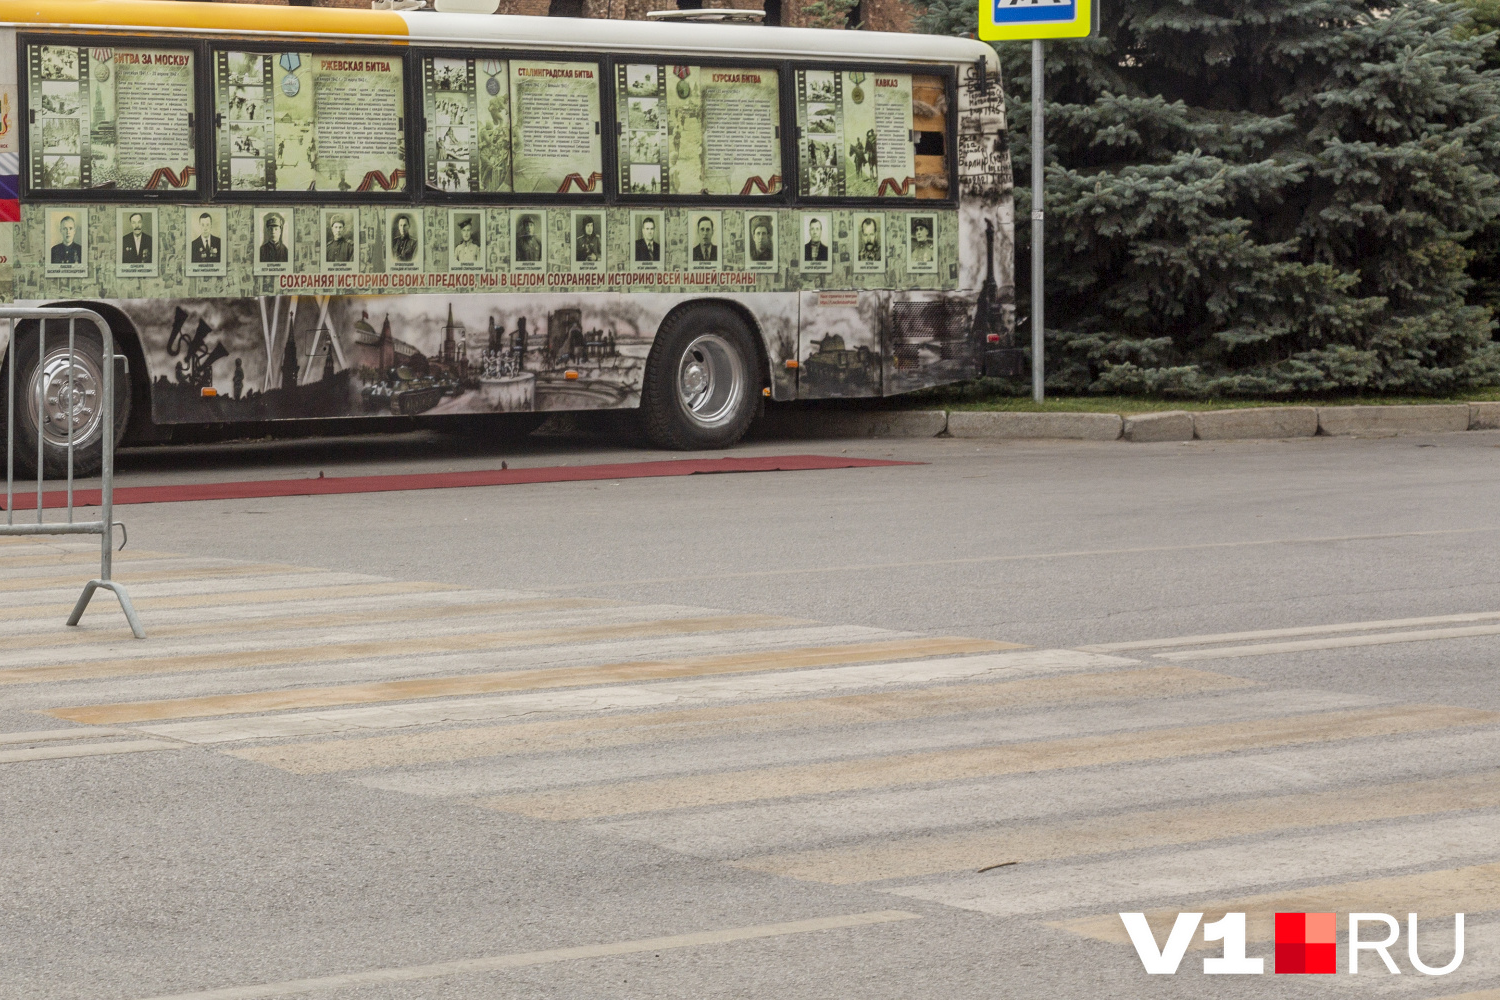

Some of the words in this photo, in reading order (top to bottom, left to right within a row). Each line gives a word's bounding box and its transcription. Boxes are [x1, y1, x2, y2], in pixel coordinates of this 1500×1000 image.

[141, 53, 152, 64] ЗА
[154, 54, 189, 66] МОСКВУ
[321, 60, 363, 71] РЖЕВСКАЯ
[365, 61, 391, 72] БИТВА
[518, 67, 573, 79] СТАЛИНГРАДСКАЯ
[574, 69, 594, 79] БИТВА
[712, 73, 740, 83] КУРСКАЯ
[741, 74, 762, 84] БИТВА
[875, 78, 898, 88] КАВКАЗ
[280, 274, 335, 288] СОХРАНЯЯ
[338, 273, 389, 288] ИСТОРИЮ
[391, 273, 426, 287] СВОИХ
[428, 273, 479, 289] ПРЕДКОВ,
[480, 273, 499, 286] МЫ
[501, 273, 507, 286] В
[509, 273, 545, 288] ЦЕЛОМ
[547, 273, 606, 286] СОХРАНЯЕМ
[608, 272, 655, 286] ИСТОРИЮ
[657, 270, 681, 285] ВСЕЙ
[683, 270, 717, 285] НАШЕЙ
[720, 272, 757, 285] СТРАНЫ
